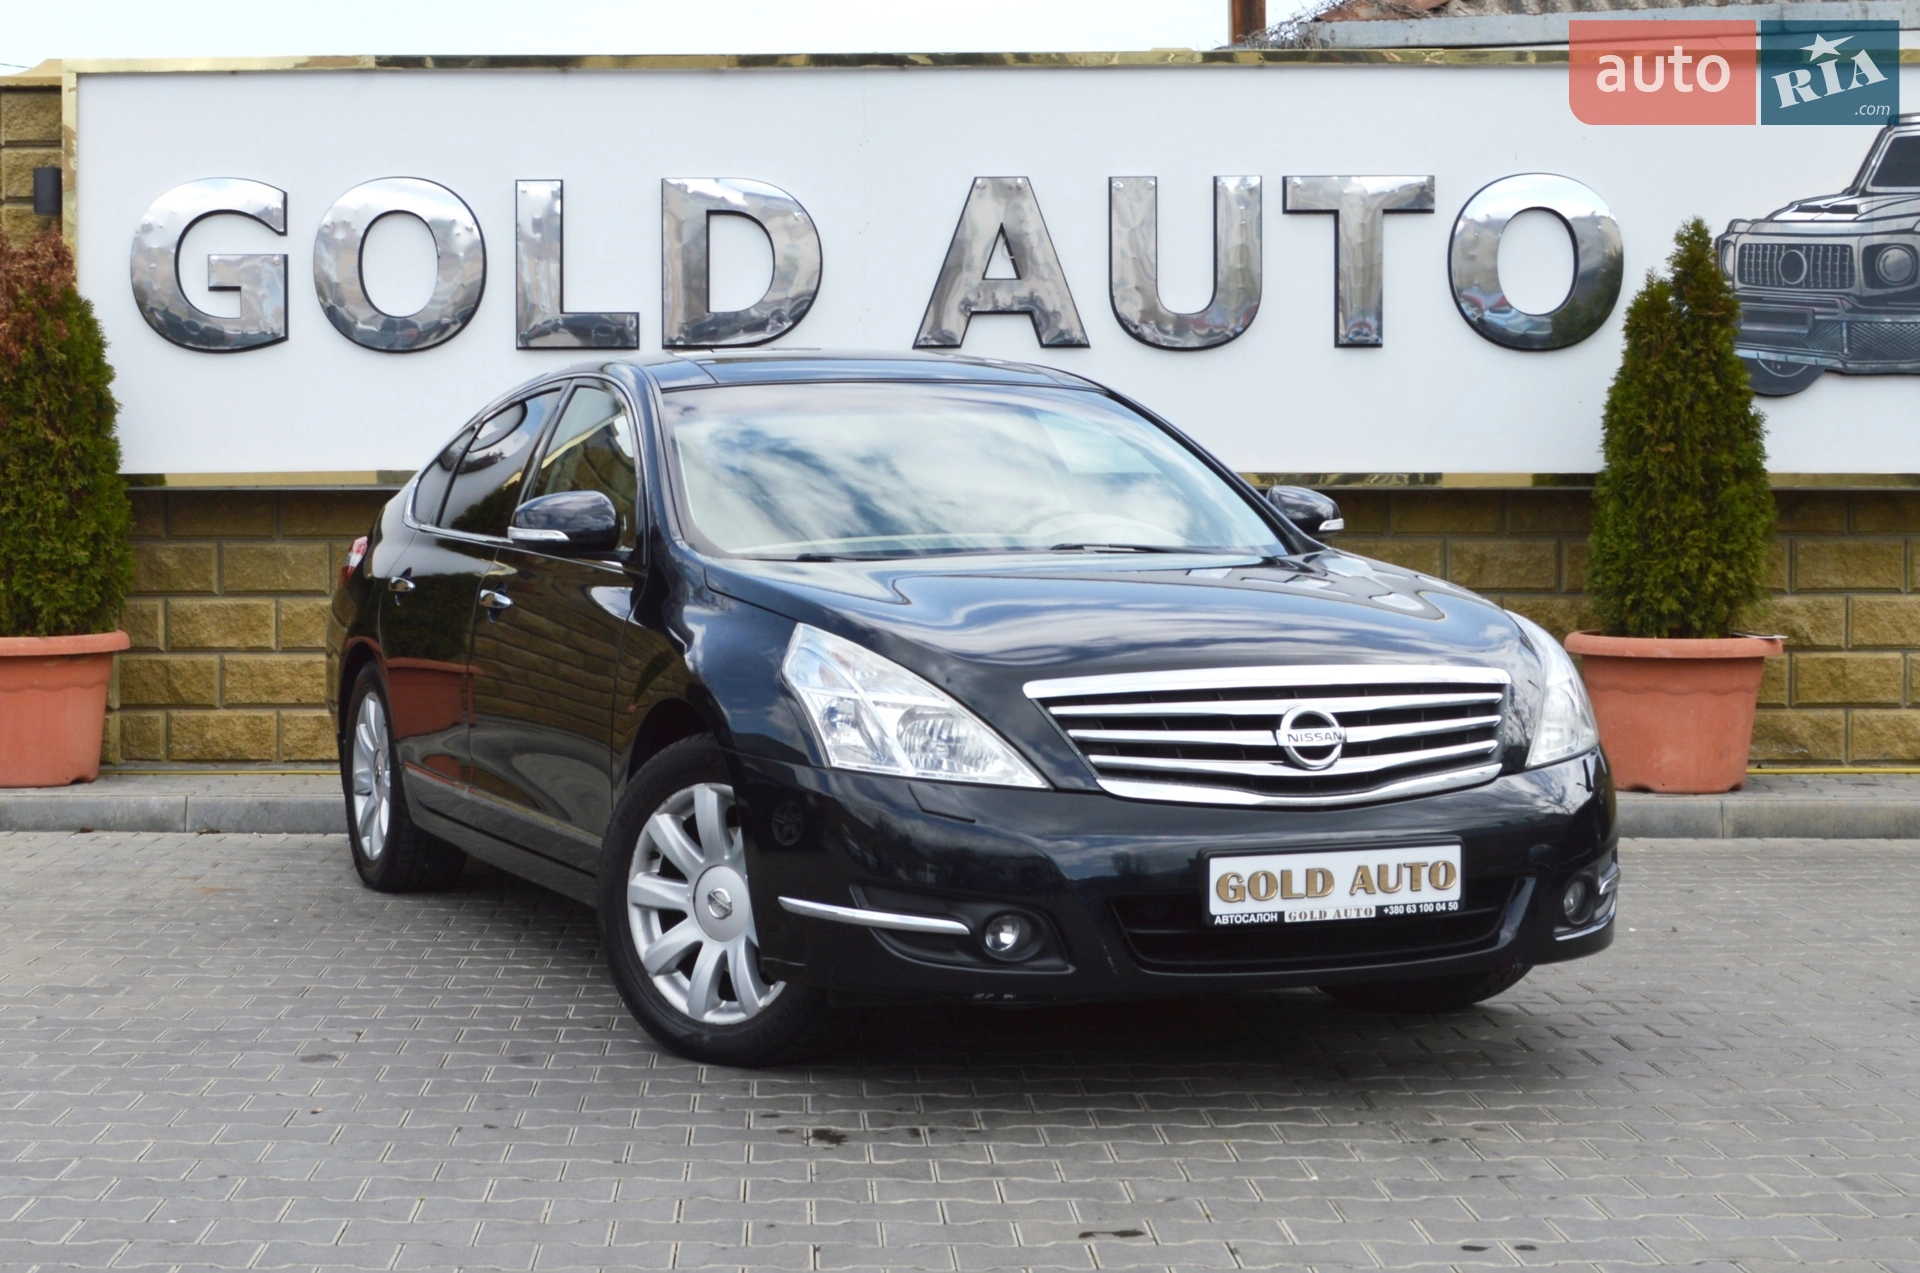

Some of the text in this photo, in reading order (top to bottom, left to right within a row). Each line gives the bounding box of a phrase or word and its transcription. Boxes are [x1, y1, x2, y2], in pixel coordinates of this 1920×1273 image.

[130, 172, 1625, 354] GOLD AUTO
[1287, 731, 1343, 743] NISSAN
[1216, 860, 1457, 902] GOLD AUTO
[1288, 907, 1373, 922] GOLD AUTO
[1383, 901, 1458, 915] +380 63 100 04 50
[1214, 912, 1278, 925] АВТОСАЛОН
